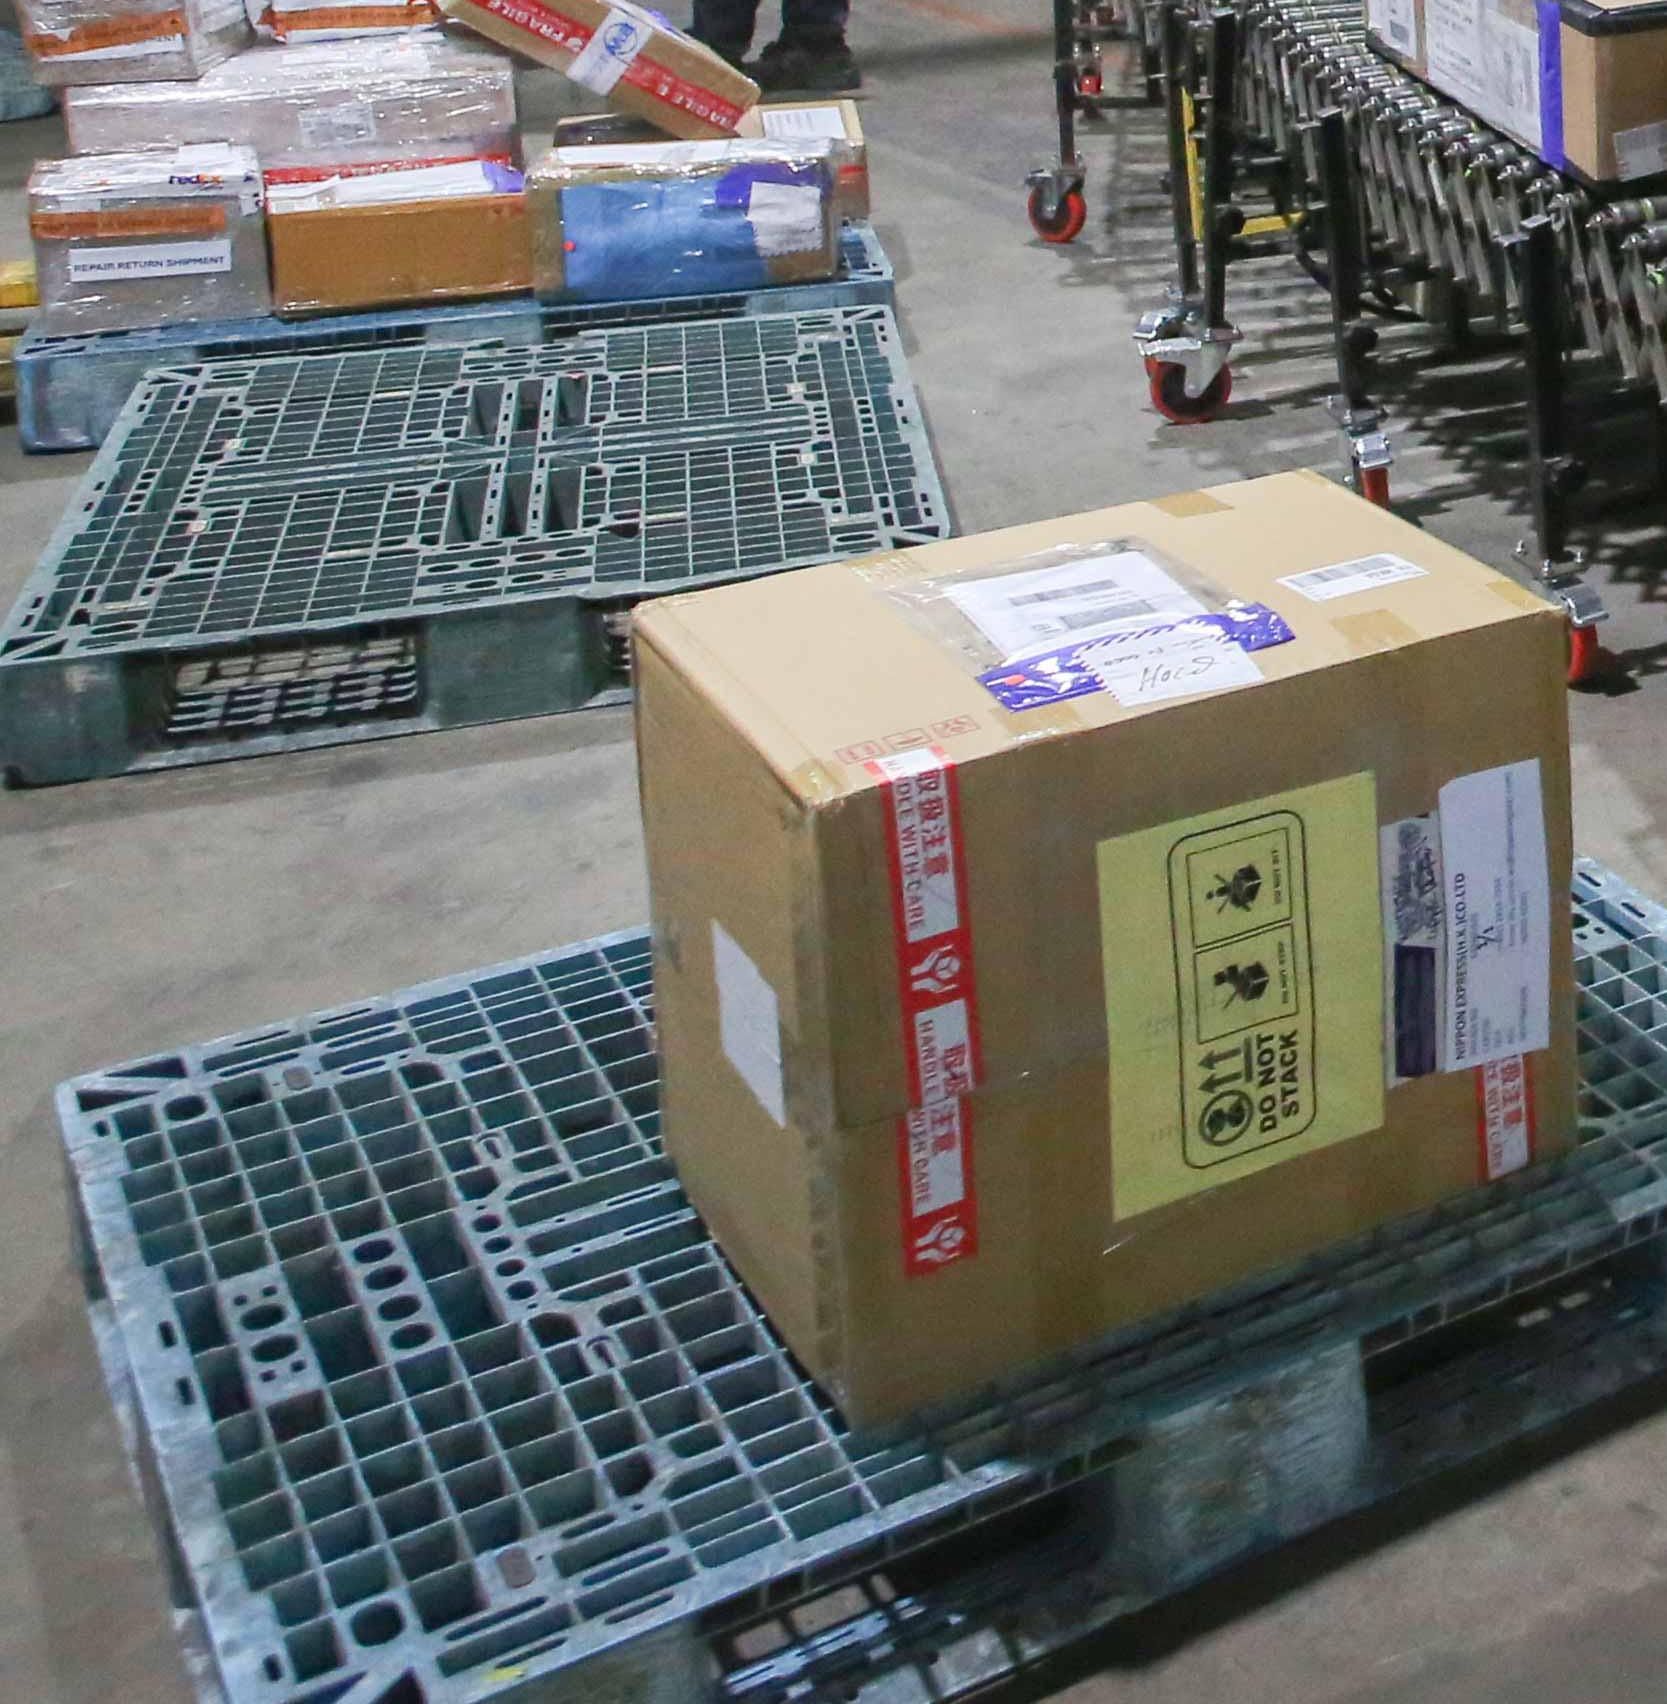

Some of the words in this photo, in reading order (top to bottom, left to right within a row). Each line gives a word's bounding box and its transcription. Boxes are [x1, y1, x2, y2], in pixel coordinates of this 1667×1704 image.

[73, 262, 115, 274] REPAIR
[117, 259, 163, 271] RETURN
[165, 256, 224, 268] SHIPMENT
[902, 825, 920, 878] WITH
[906, 881, 927, 928] CARE
[919, 1018, 941, 1099] HANDLE
[1256, 1031, 1276, 1086] NOT
[1454, 1010, 1467, 1061] NIPPON
[1279, 1028, 1300, 1117] STACK
[1259, 1095, 1277, 1133] DO
[913, 1158, 933, 1205] CARE
